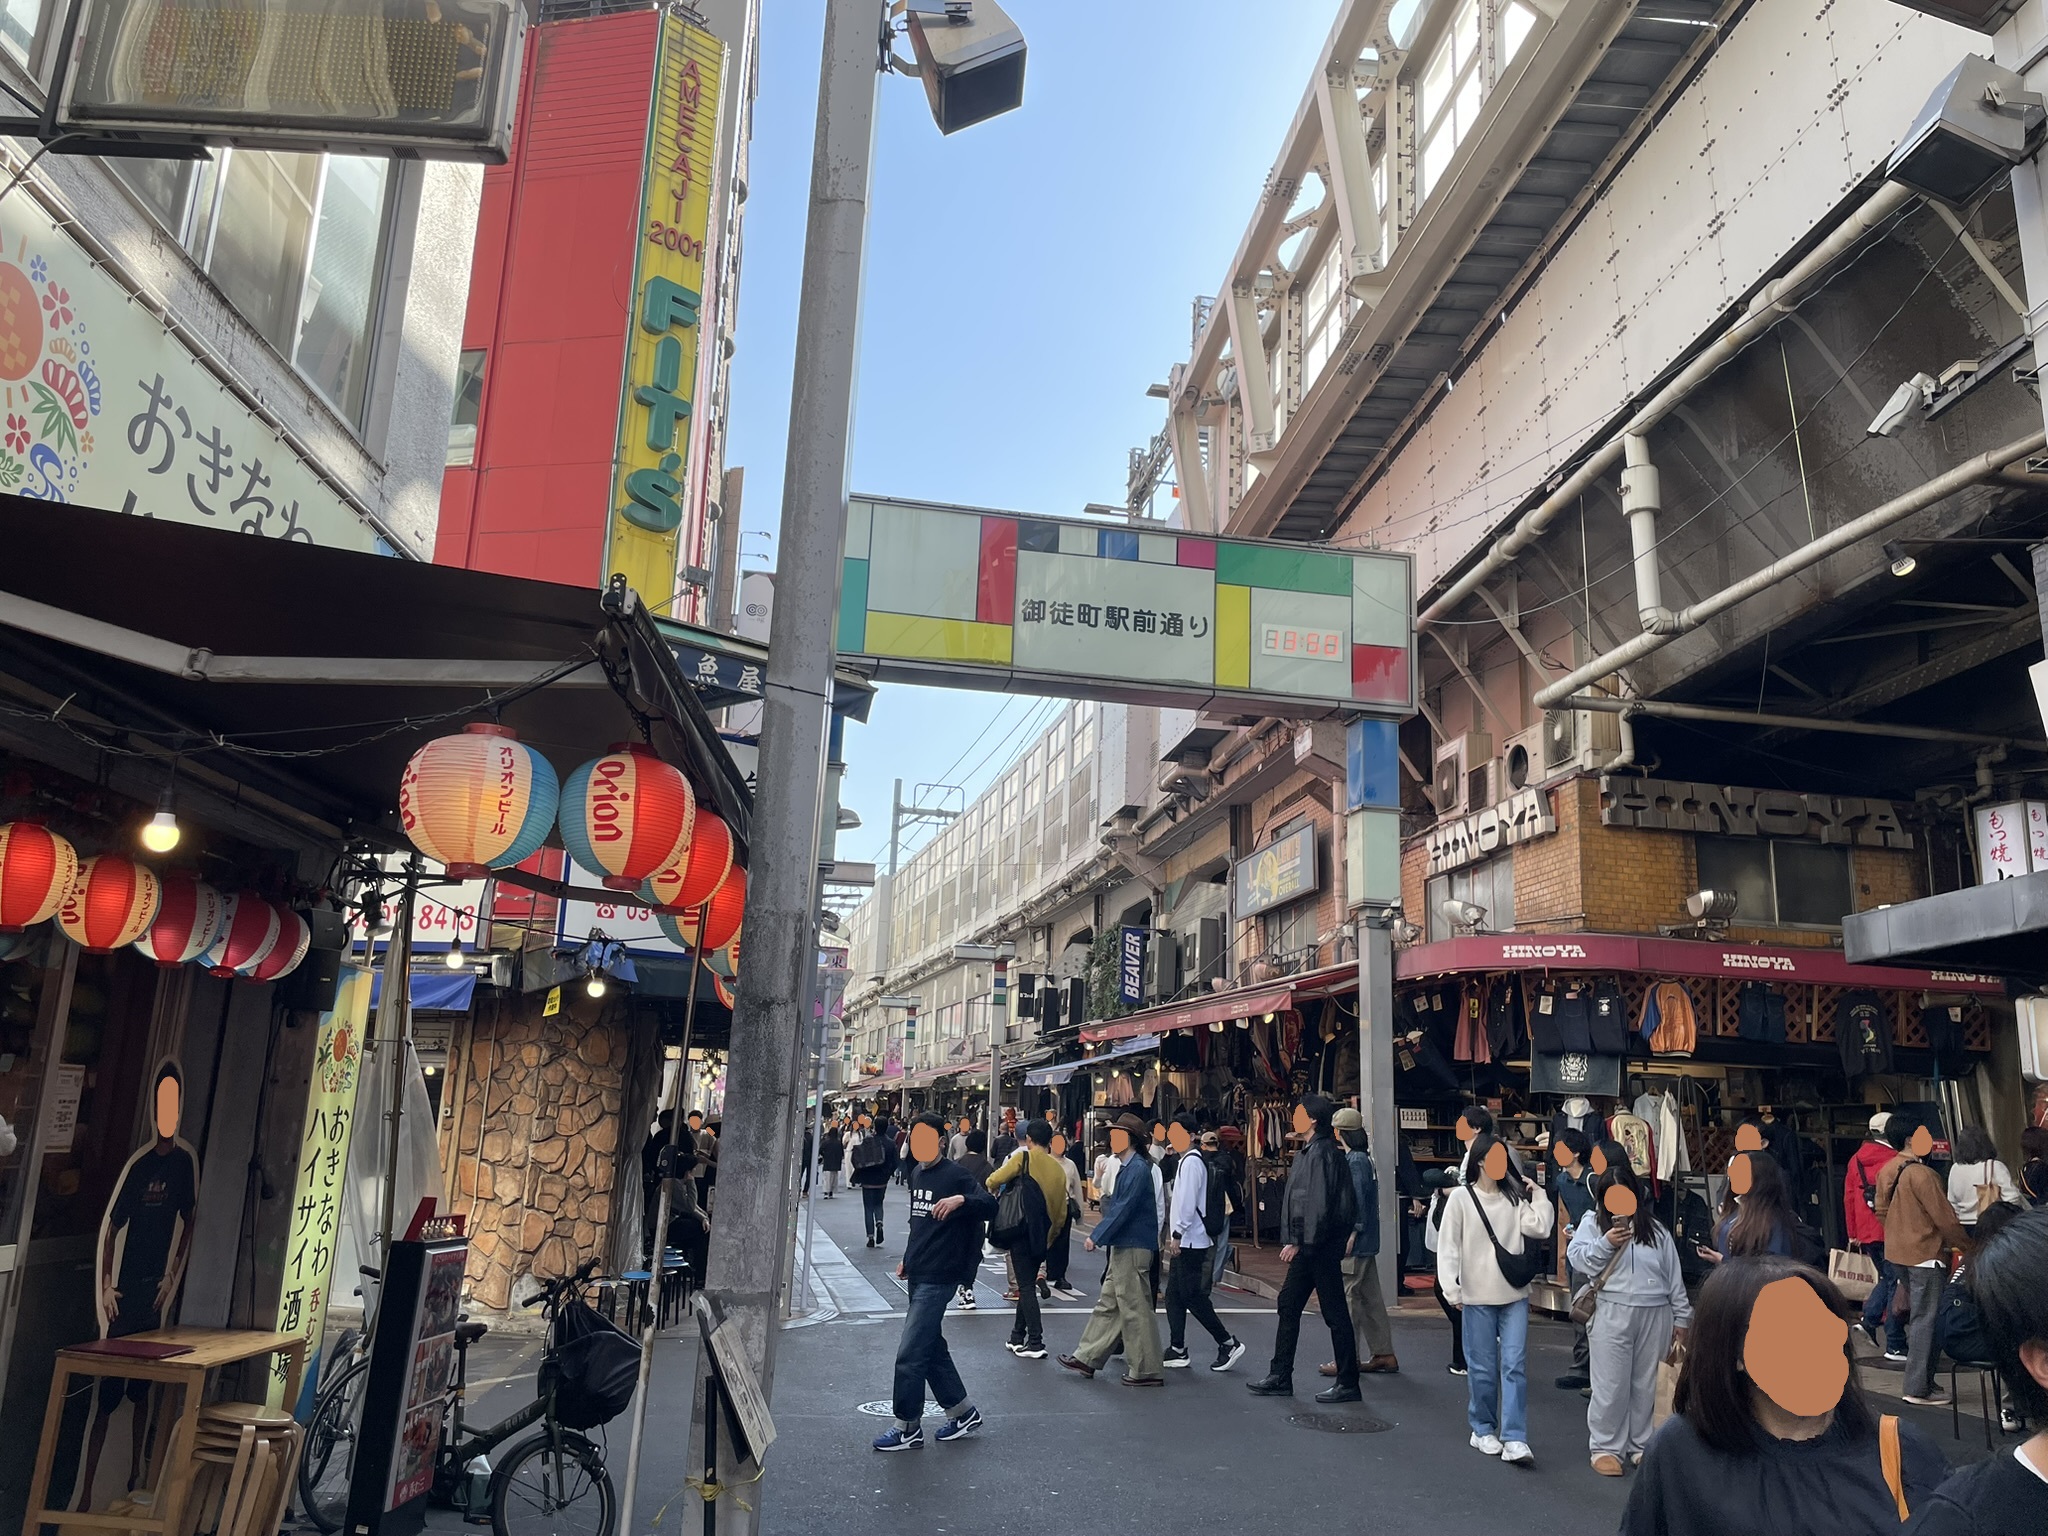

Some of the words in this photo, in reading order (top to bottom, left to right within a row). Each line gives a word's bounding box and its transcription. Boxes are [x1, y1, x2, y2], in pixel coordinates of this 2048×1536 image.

[671, 59, 700, 224] AMECAJI
[650, 220, 703, 262] 2001
[1021, 598, 1209, 639] 御徒町駅前通り
[490, 747, 515, 835] オリオンビール
[593, 761, 630, 841] Orion
[1601, 776, 1913, 849] HINOYA
[1426, 788, 1556, 878] HINOYA
[130, 874, 153, 933] オリオンビール
[1124, 932, 1140, 999] BEAVER
[1503, 945, 1586, 958] HINOYA
[1723, 953, 1796, 971] HINOYA
[311, 1105, 350, 1277] おきなわ
